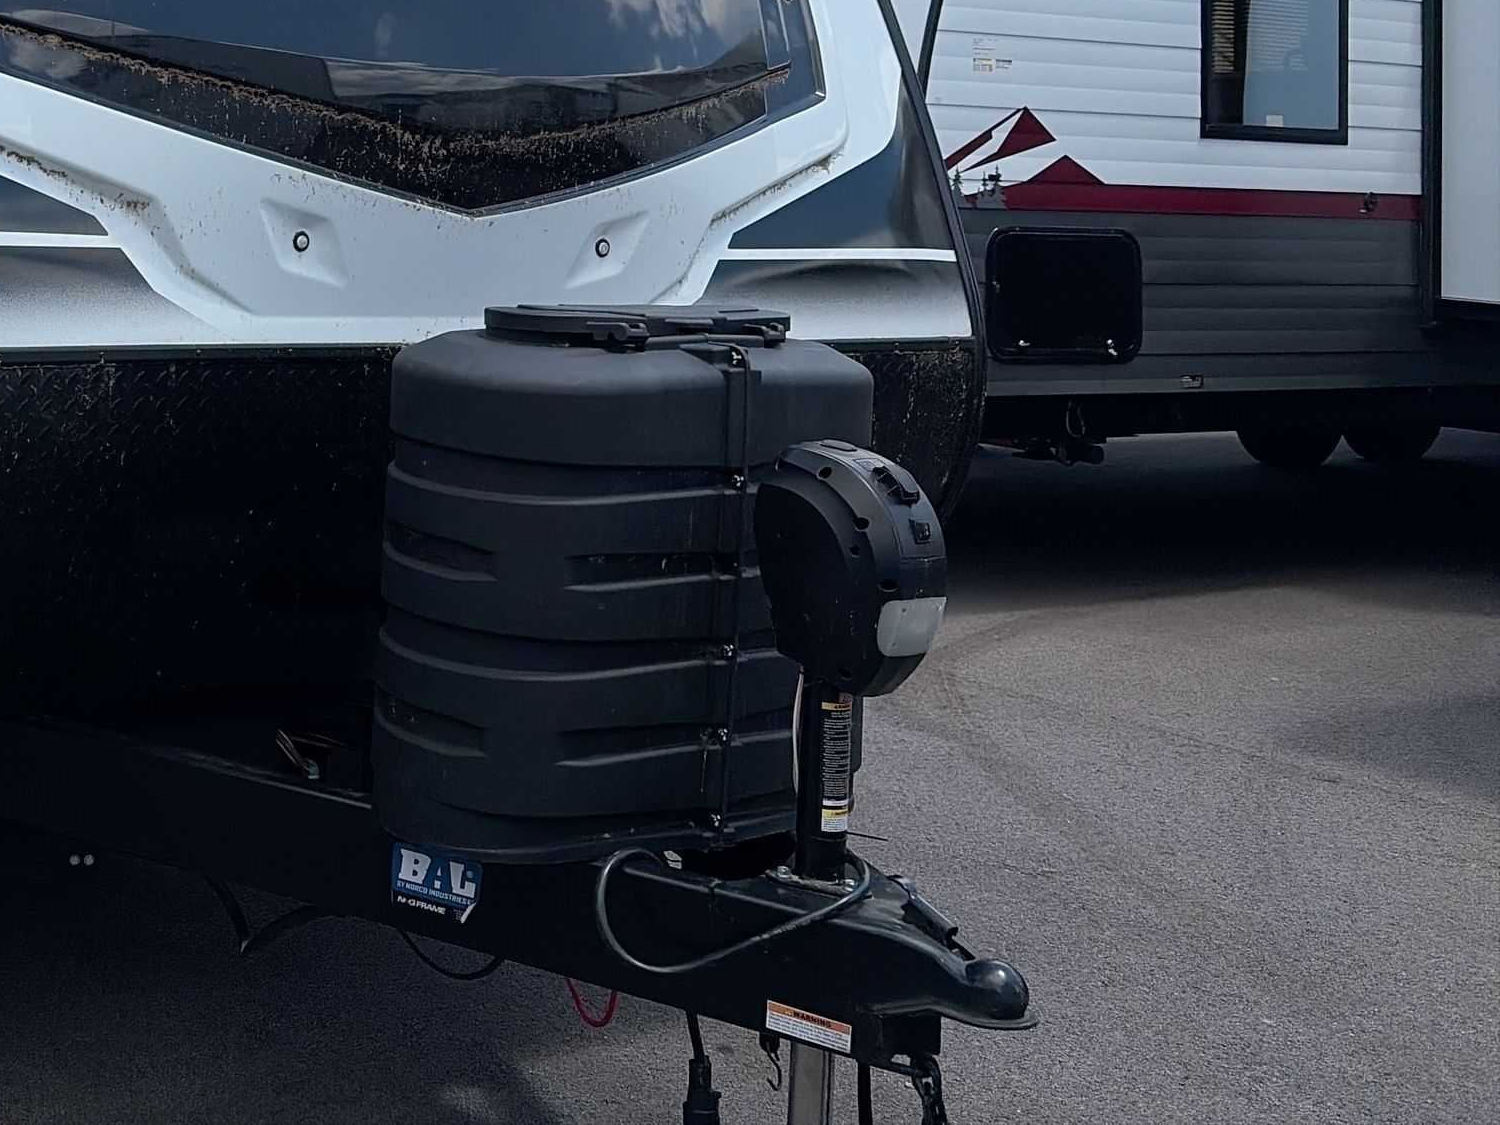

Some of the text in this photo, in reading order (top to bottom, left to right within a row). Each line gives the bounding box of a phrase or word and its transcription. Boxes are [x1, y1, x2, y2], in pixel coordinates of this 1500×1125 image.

[398, 848, 476, 898] BAL
[396, 879, 405, 888] BY
[405, 882, 428, 894] NORCO
[429, 889, 468, 905] INDUSTRIES
[793, 1010, 832, 1028] WARNING
